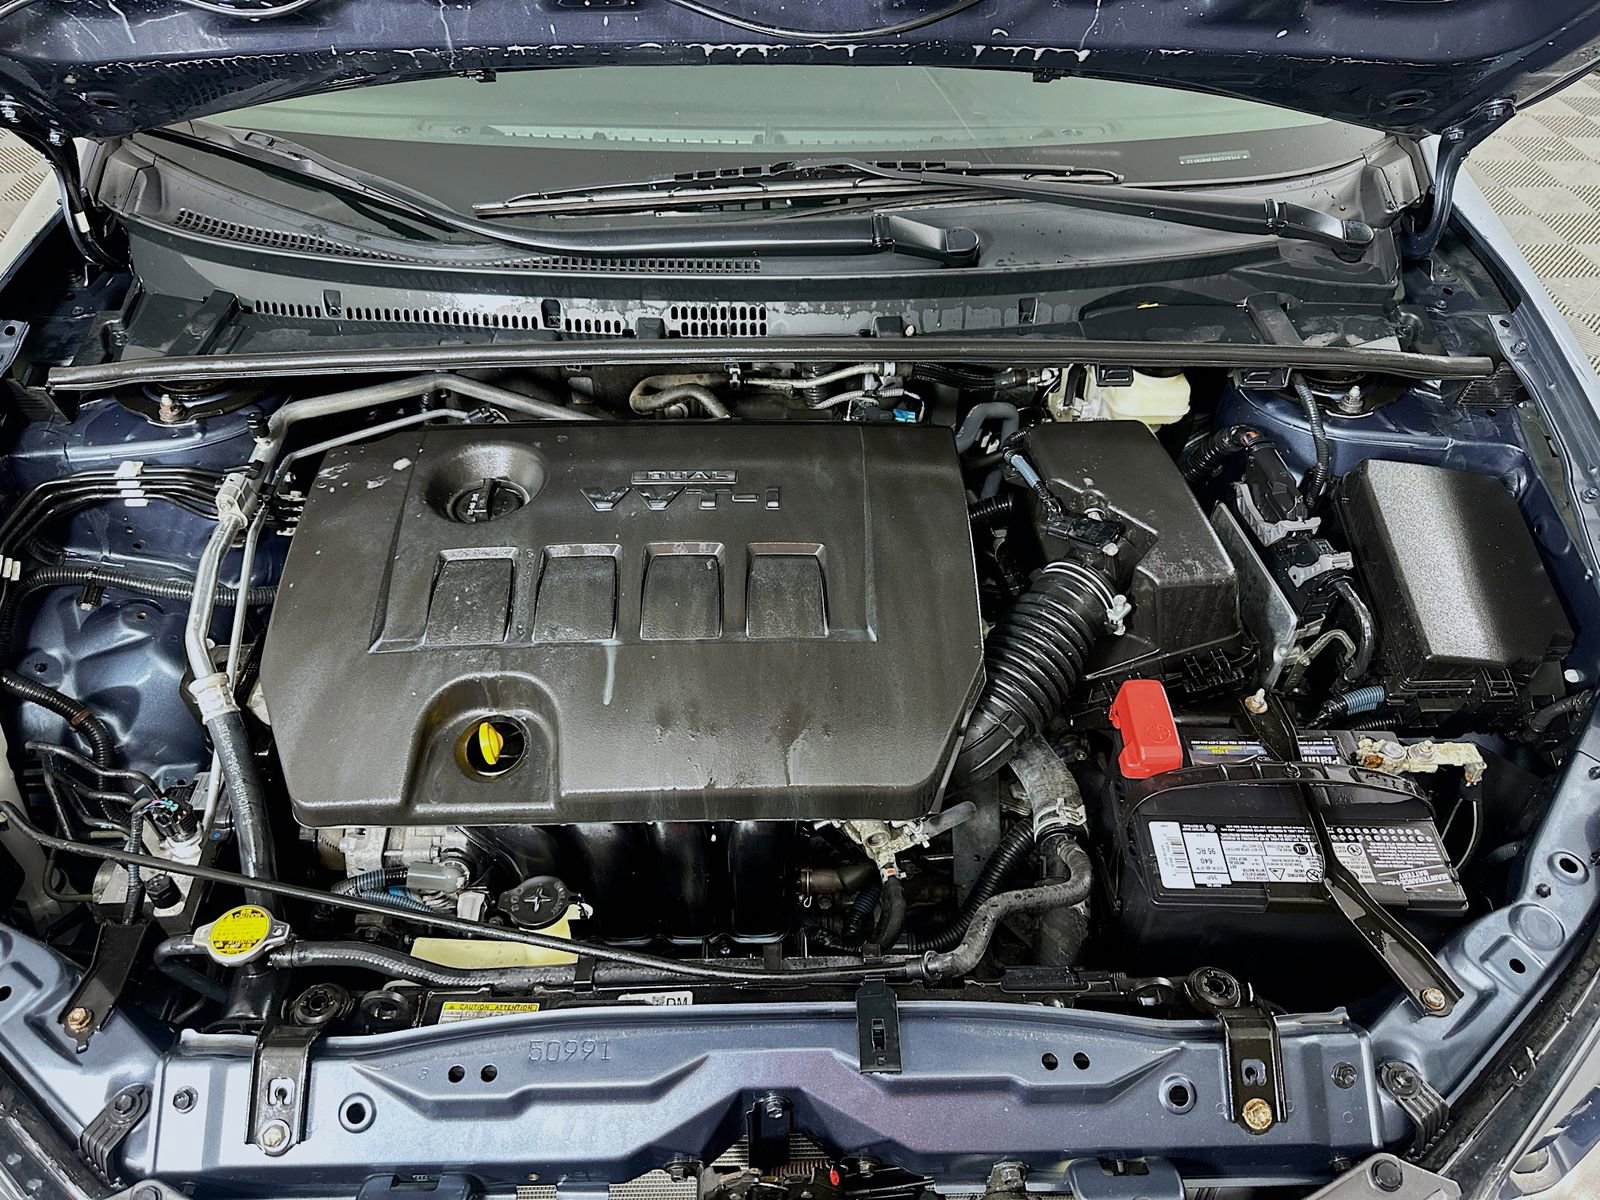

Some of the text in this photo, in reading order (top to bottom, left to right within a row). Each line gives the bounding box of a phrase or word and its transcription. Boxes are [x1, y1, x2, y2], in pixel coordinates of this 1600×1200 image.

[647, 470, 730, 480] DUAL
[495, 1003, 533, 1011] ATTENTION
[528, 1039, 611, 1062] 50991
